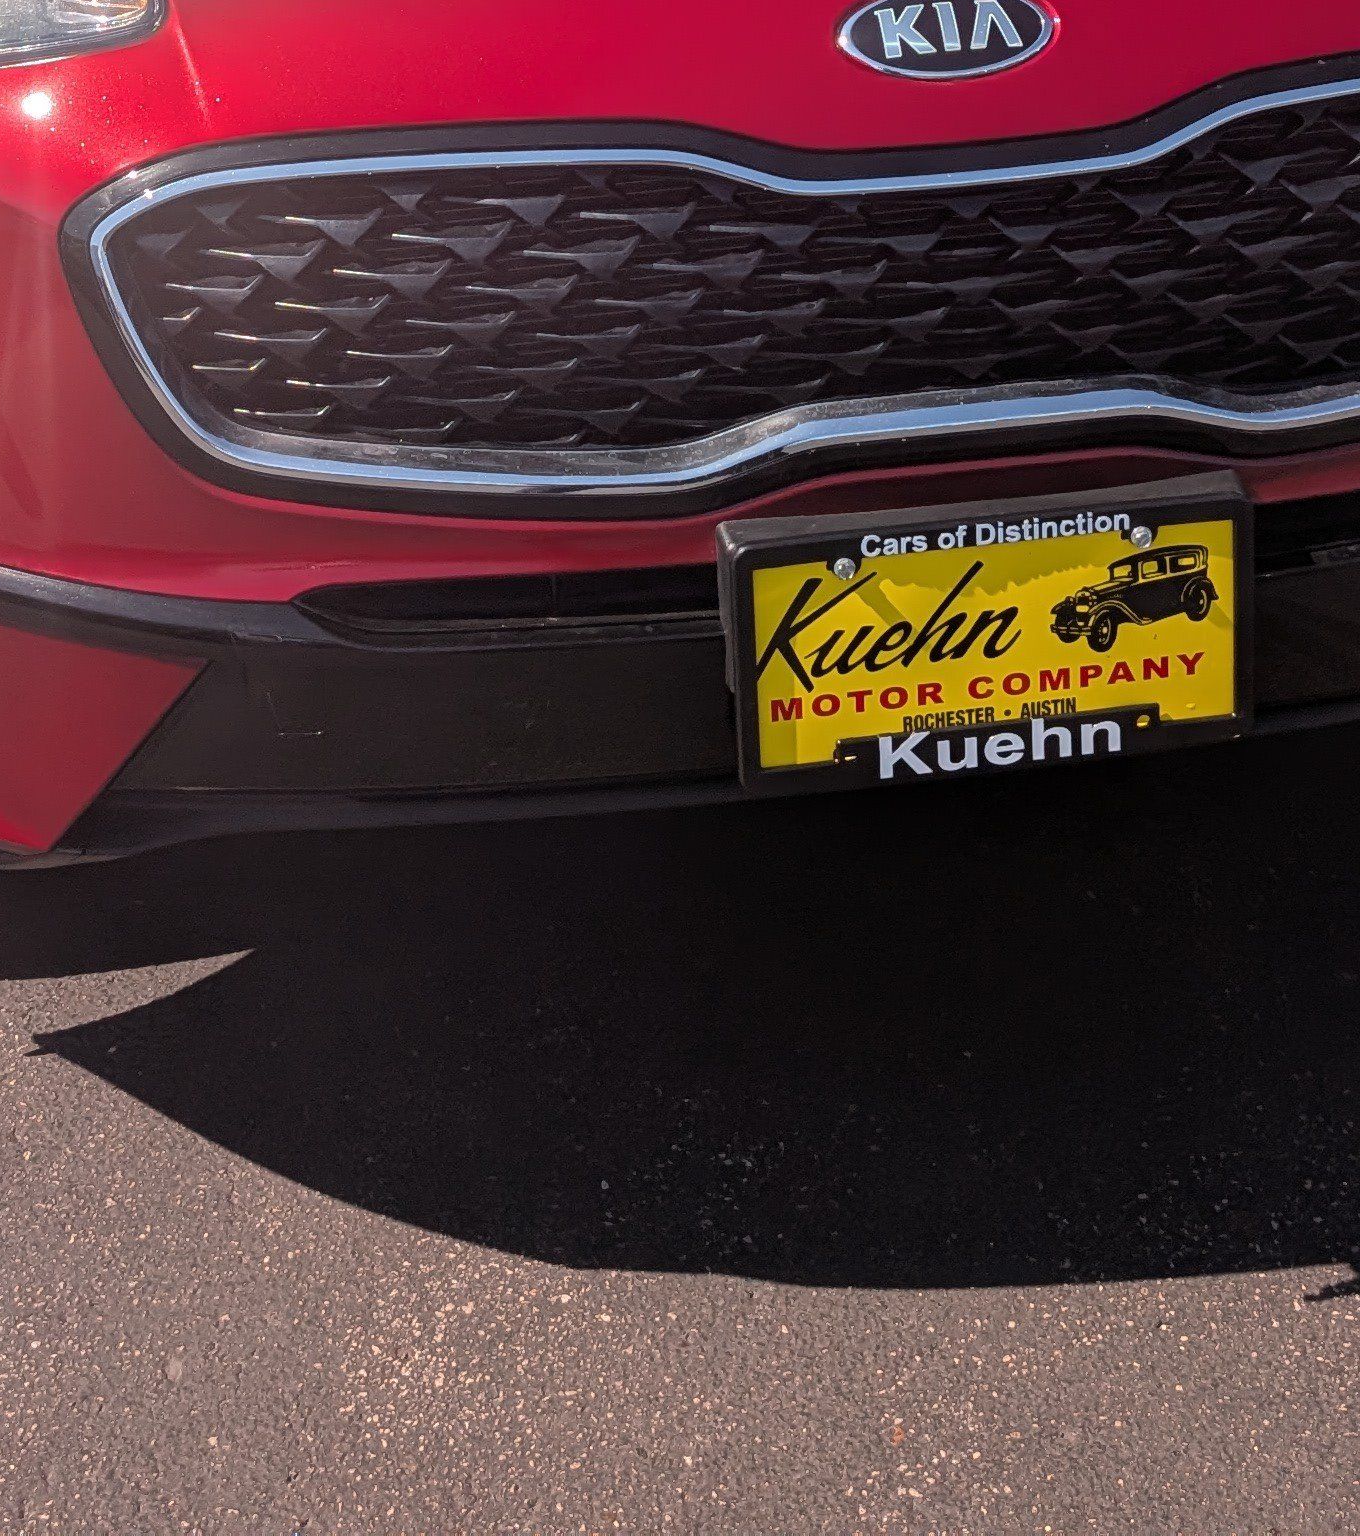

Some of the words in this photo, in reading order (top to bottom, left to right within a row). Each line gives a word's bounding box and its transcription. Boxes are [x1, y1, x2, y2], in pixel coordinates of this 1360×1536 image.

[874, 0, 1023, 59] KIA
[860, 533, 928, 559] Cars
[935, 526, 967, 551] of
[975, 512, 1131, 545] Distinction
[757, 560, 1022, 692] Kuehn
[770, 682, 943, 722] MOTOR
[968, 651, 1205, 700] COMPANY
[902, 707, 995, 732] ROCHESTER
[1020, 697, 1077, 719] AUSTIN
[878, 716, 1122, 780] Kuehn
